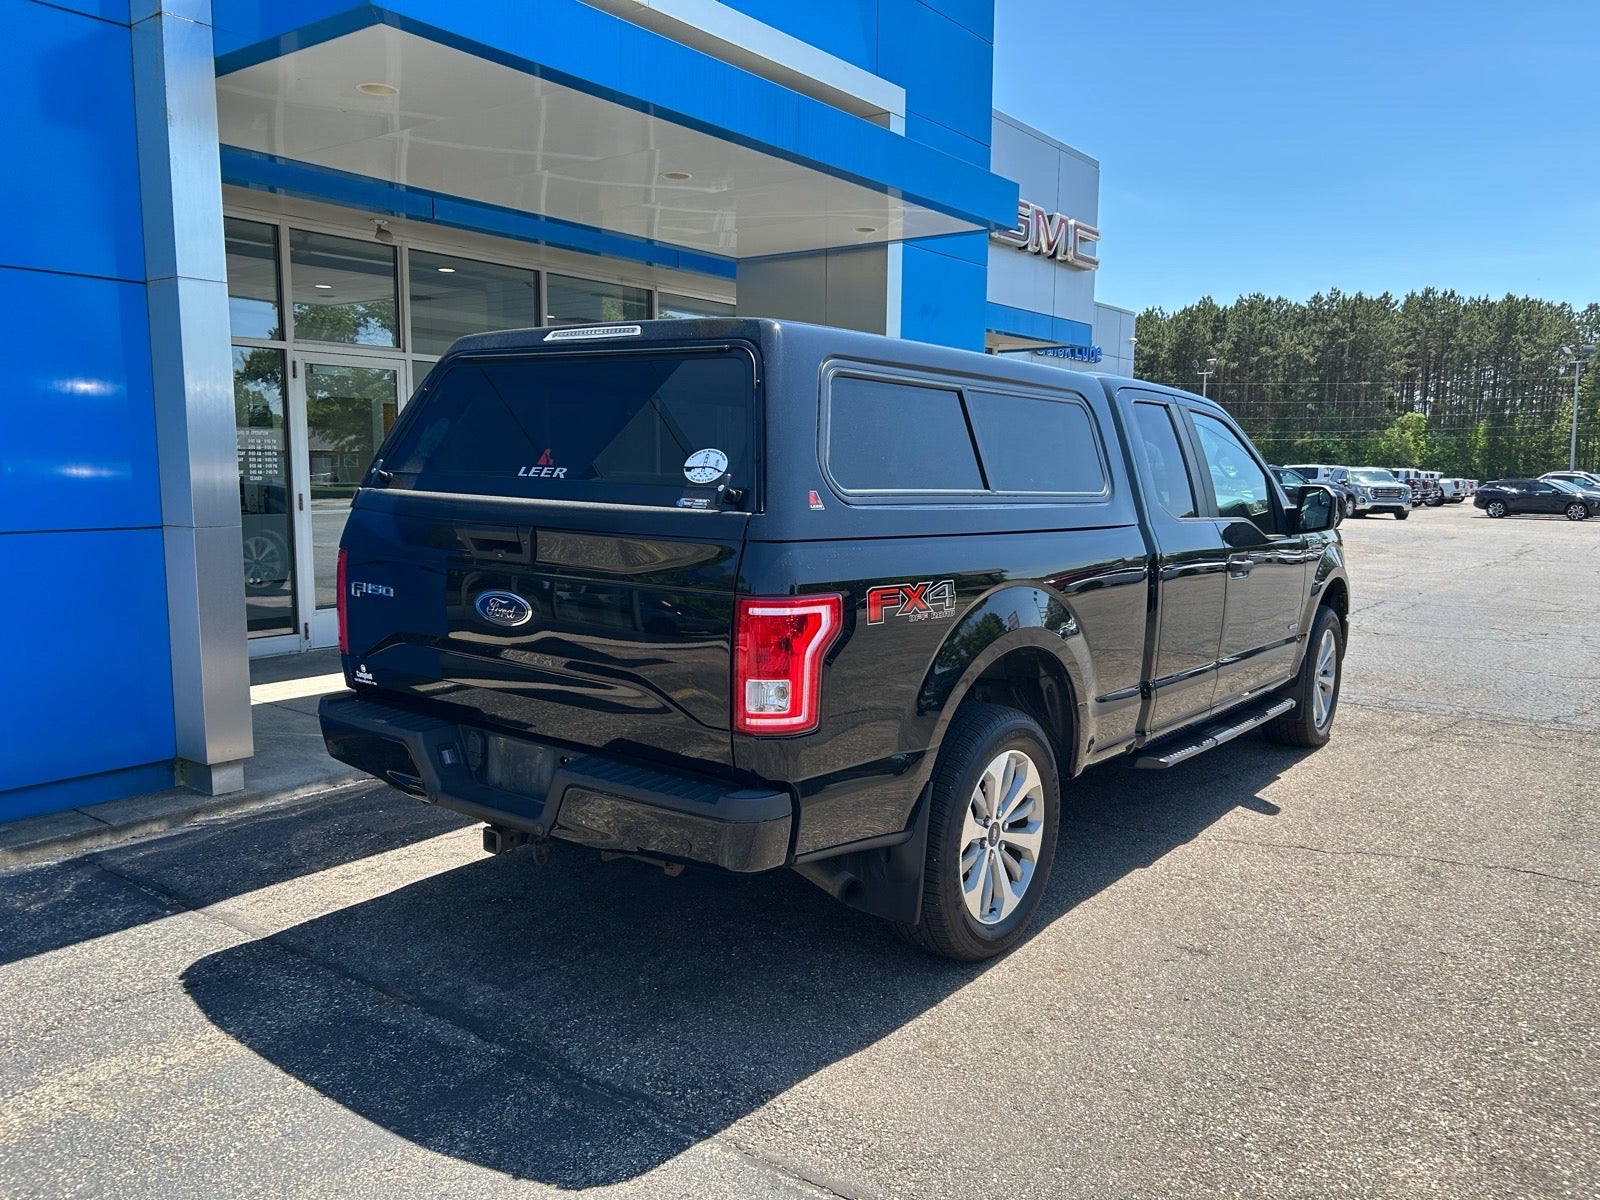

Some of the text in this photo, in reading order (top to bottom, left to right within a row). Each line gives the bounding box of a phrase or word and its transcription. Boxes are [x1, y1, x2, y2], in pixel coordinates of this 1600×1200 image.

[517, 466, 568, 479] LEER
[486, 597, 517, 619] Ford
[866, 579, 957, 626] FX4
[908, 609, 956, 622] OFF ROAD
